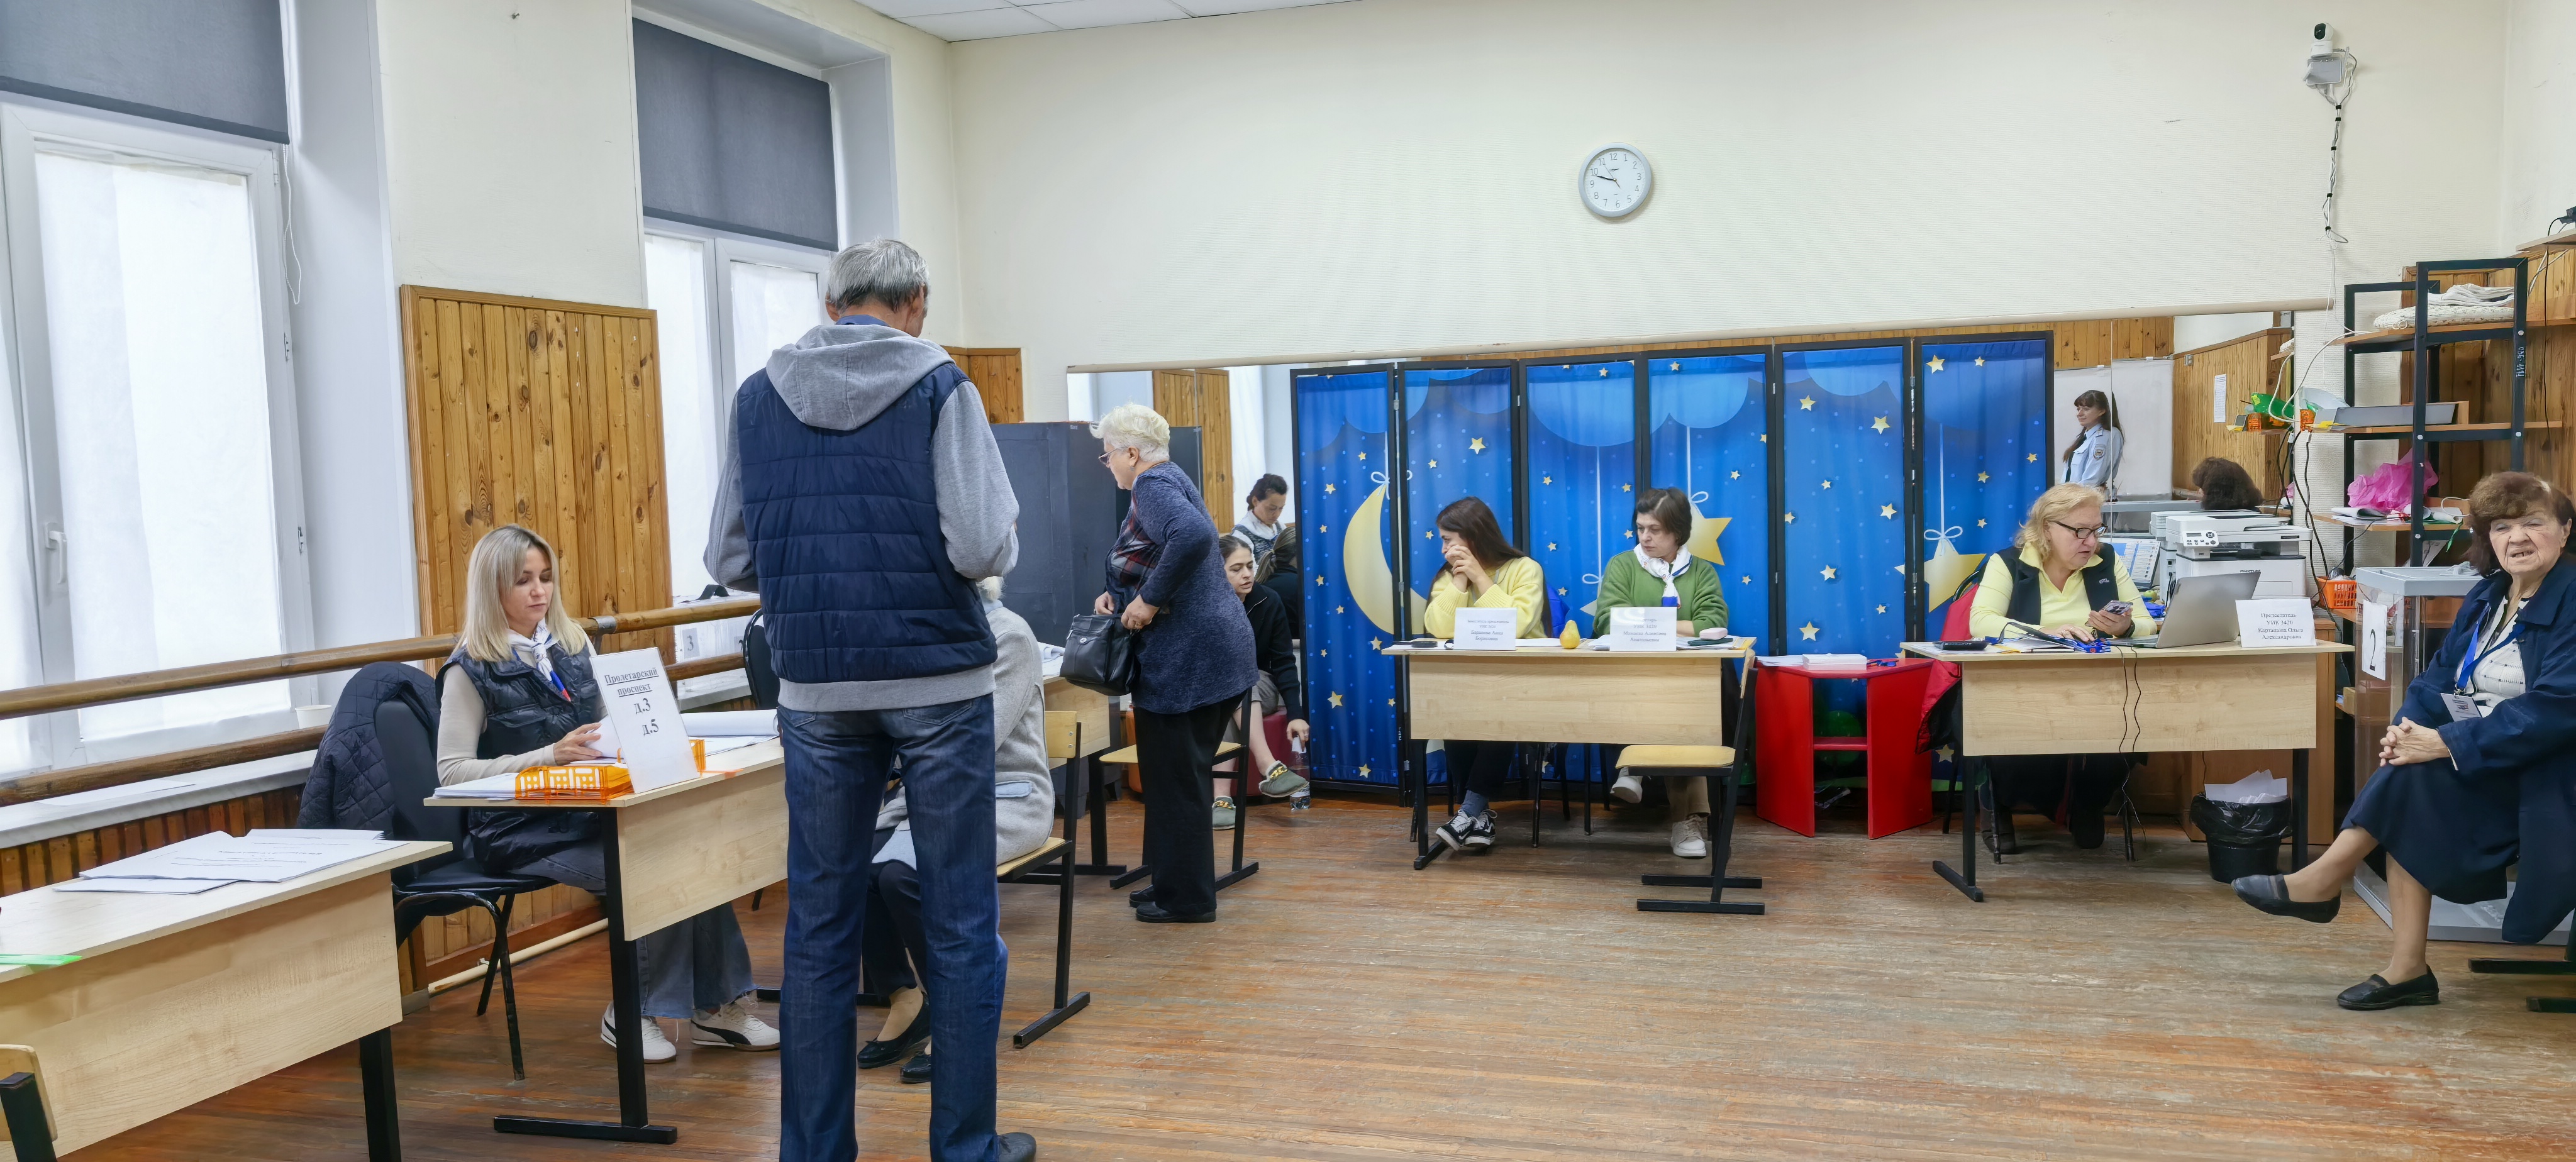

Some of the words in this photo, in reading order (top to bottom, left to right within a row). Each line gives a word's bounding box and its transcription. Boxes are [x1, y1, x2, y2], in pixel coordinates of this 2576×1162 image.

[1590, 168, 1599, 176] 10
[1633, 161, 1638, 169] 2
[1589, 180, 1595, 188] 9
[1603, 199, 1607, 207] 7
[687, 635, 694, 651] 3
[2370, 629, 2376, 671] 2
[604, 667, 658, 684] Пролетарский
[617, 683, 652, 696] проспект
[634, 698, 651, 715] д.3
[641, 719, 659, 736] д.5
